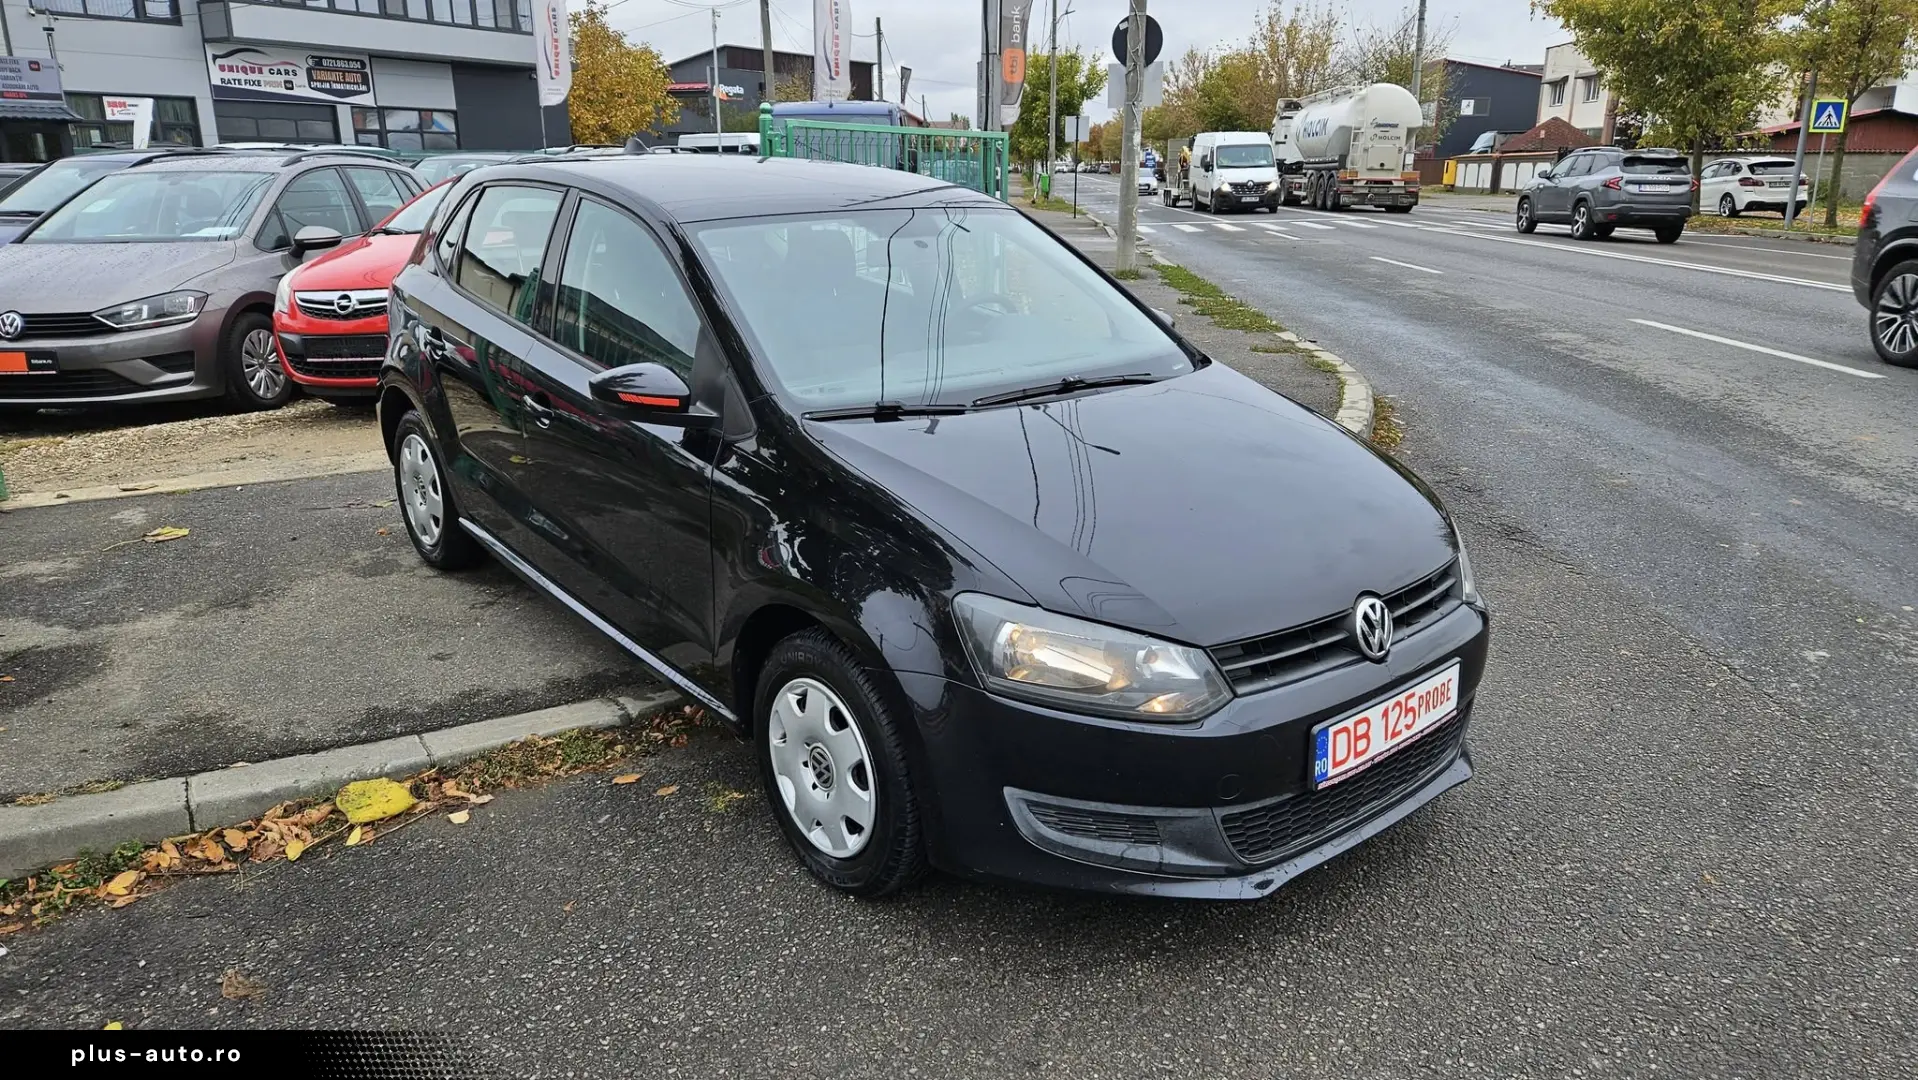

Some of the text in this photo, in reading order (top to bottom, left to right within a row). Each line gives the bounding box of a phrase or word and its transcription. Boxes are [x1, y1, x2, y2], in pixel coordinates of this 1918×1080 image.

[1011, 5, 1020, 43] bank
[218, 64, 298, 76] UNIQUE CARS
[311, 69, 362, 84] VARIANTE AUTO
[220, 77, 242, 86] RATE
[244, 79, 262, 87] FIXE
[719, 83, 744, 96] Regata
[1303, 117, 1330, 139] HOLCIM
[1332, 716, 1371, 769] DB
[1381, 691, 1416, 744] 125
[1418, 678, 1453, 718] PROBE
[1314, 756, 1328, 777] RO
